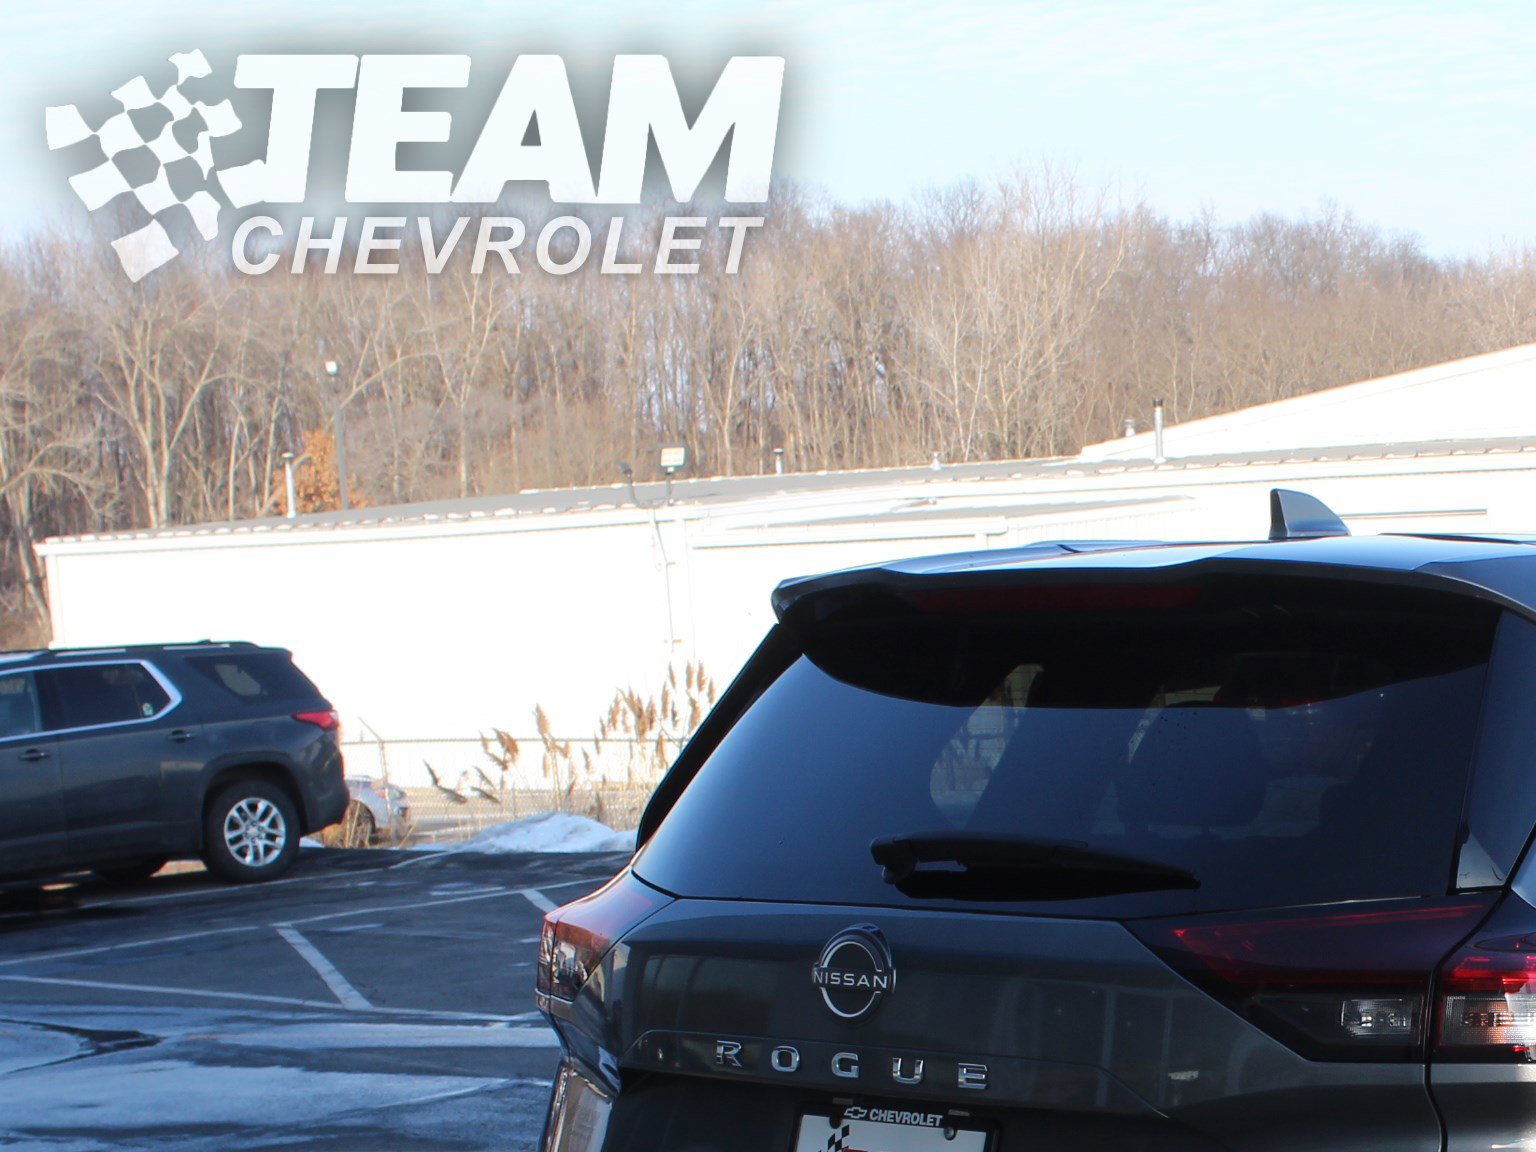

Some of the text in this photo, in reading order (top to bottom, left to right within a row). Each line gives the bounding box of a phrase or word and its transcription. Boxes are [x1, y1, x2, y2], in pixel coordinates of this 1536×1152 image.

[812, 968, 889, 990] NISSAN
[715, 1039, 989, 1090] ROGUE
[869, 1108, 943, 1127] CHEVROLET
